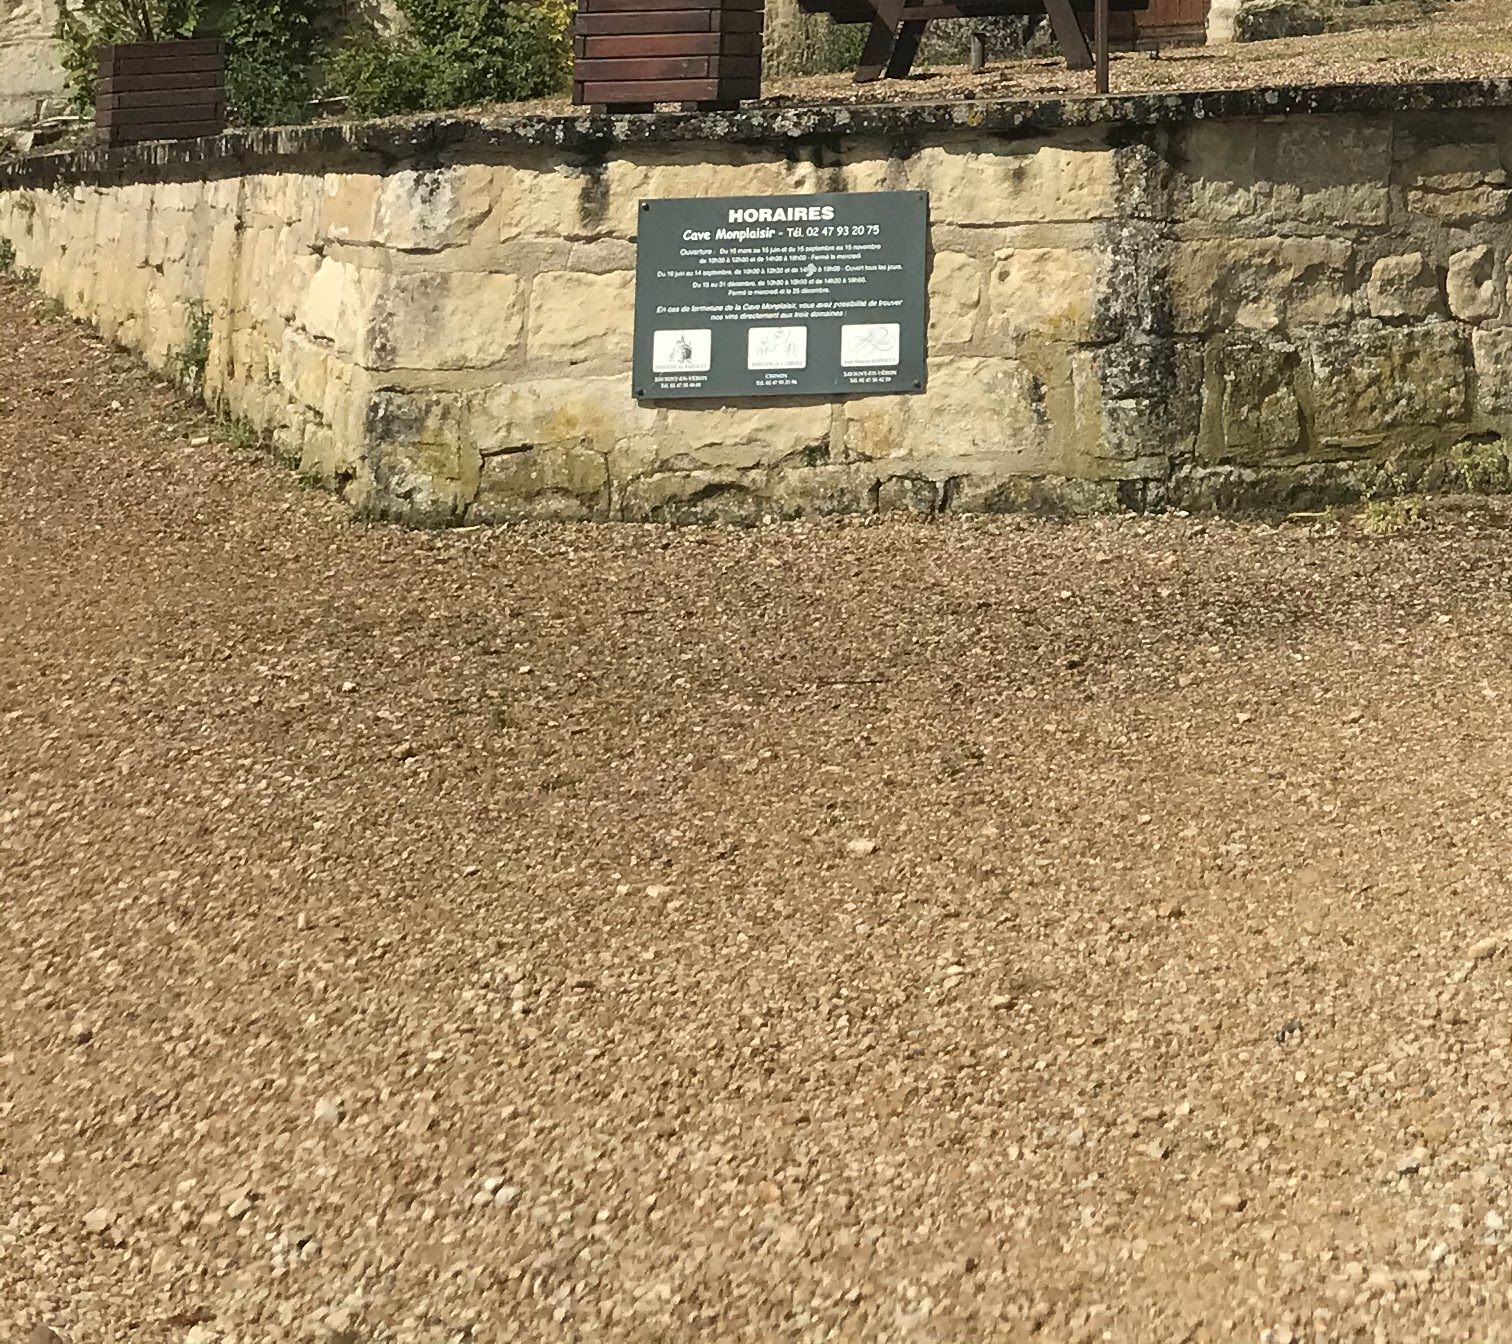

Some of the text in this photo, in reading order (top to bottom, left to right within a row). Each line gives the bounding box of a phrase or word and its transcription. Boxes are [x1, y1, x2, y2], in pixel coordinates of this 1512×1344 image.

[728, 205, 835, 223] HORAIRES
[682, 228, 711, 241] Cave
[715, 226, 776, 243] Monplaisir
[806, 226, 819, 237] 02
[821, 226, 835, 237] 47
[837, 225, 850, 236] 93
[851, 225, 865, 235] 20
[866, 224, 880, 235] 75
